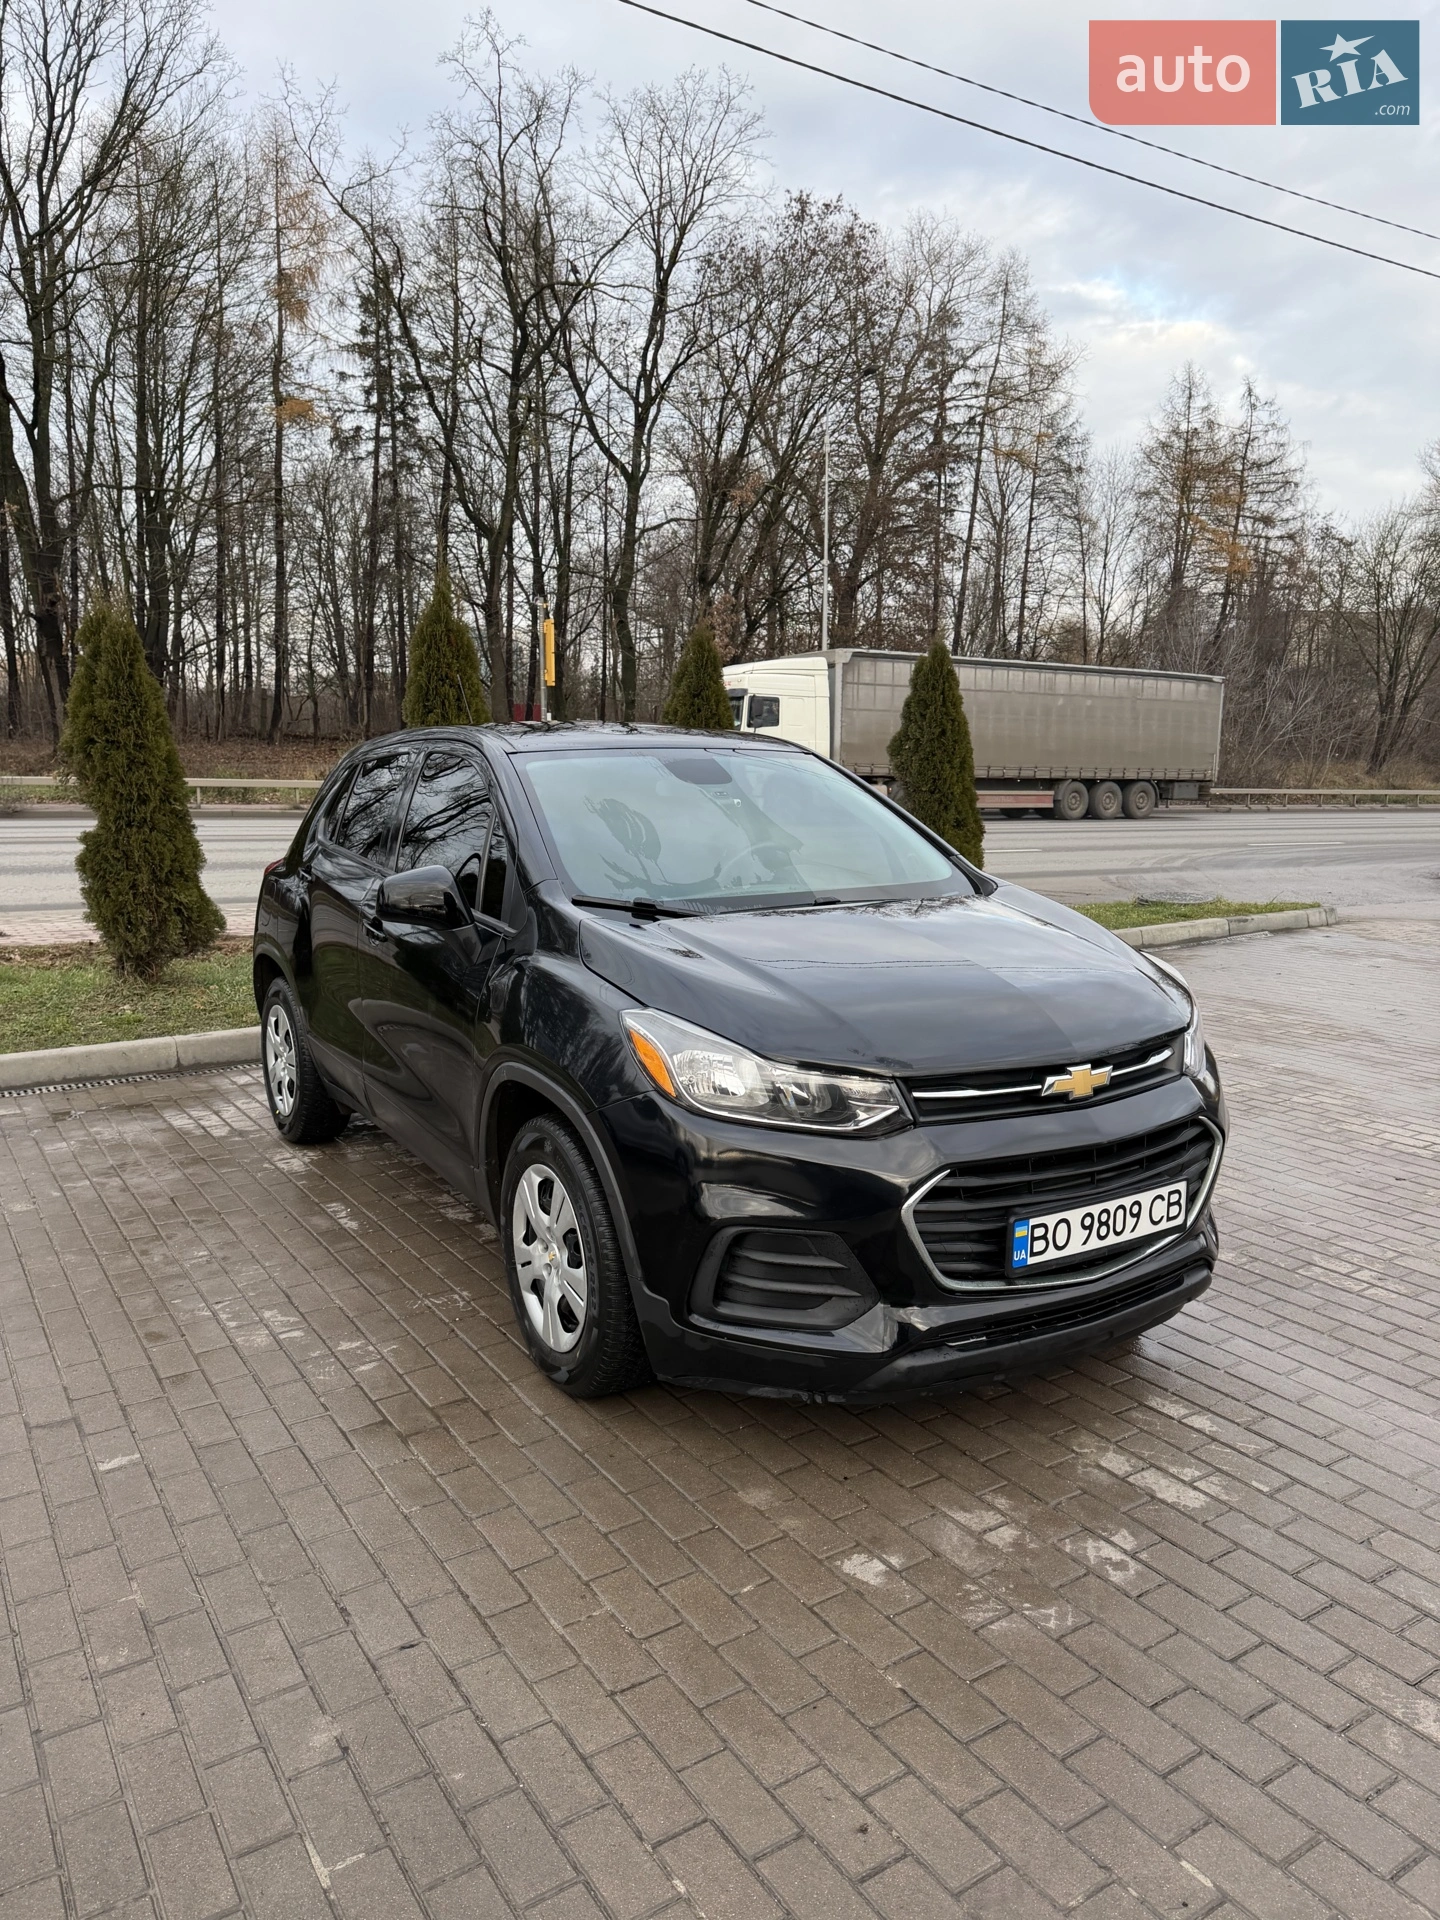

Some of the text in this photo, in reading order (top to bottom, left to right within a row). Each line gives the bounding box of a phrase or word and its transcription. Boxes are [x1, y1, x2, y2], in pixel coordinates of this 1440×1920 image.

[1029, 1188, 1183, 1258] BO 9809 CB
[1013, 1249, 1027, 1261] UA
